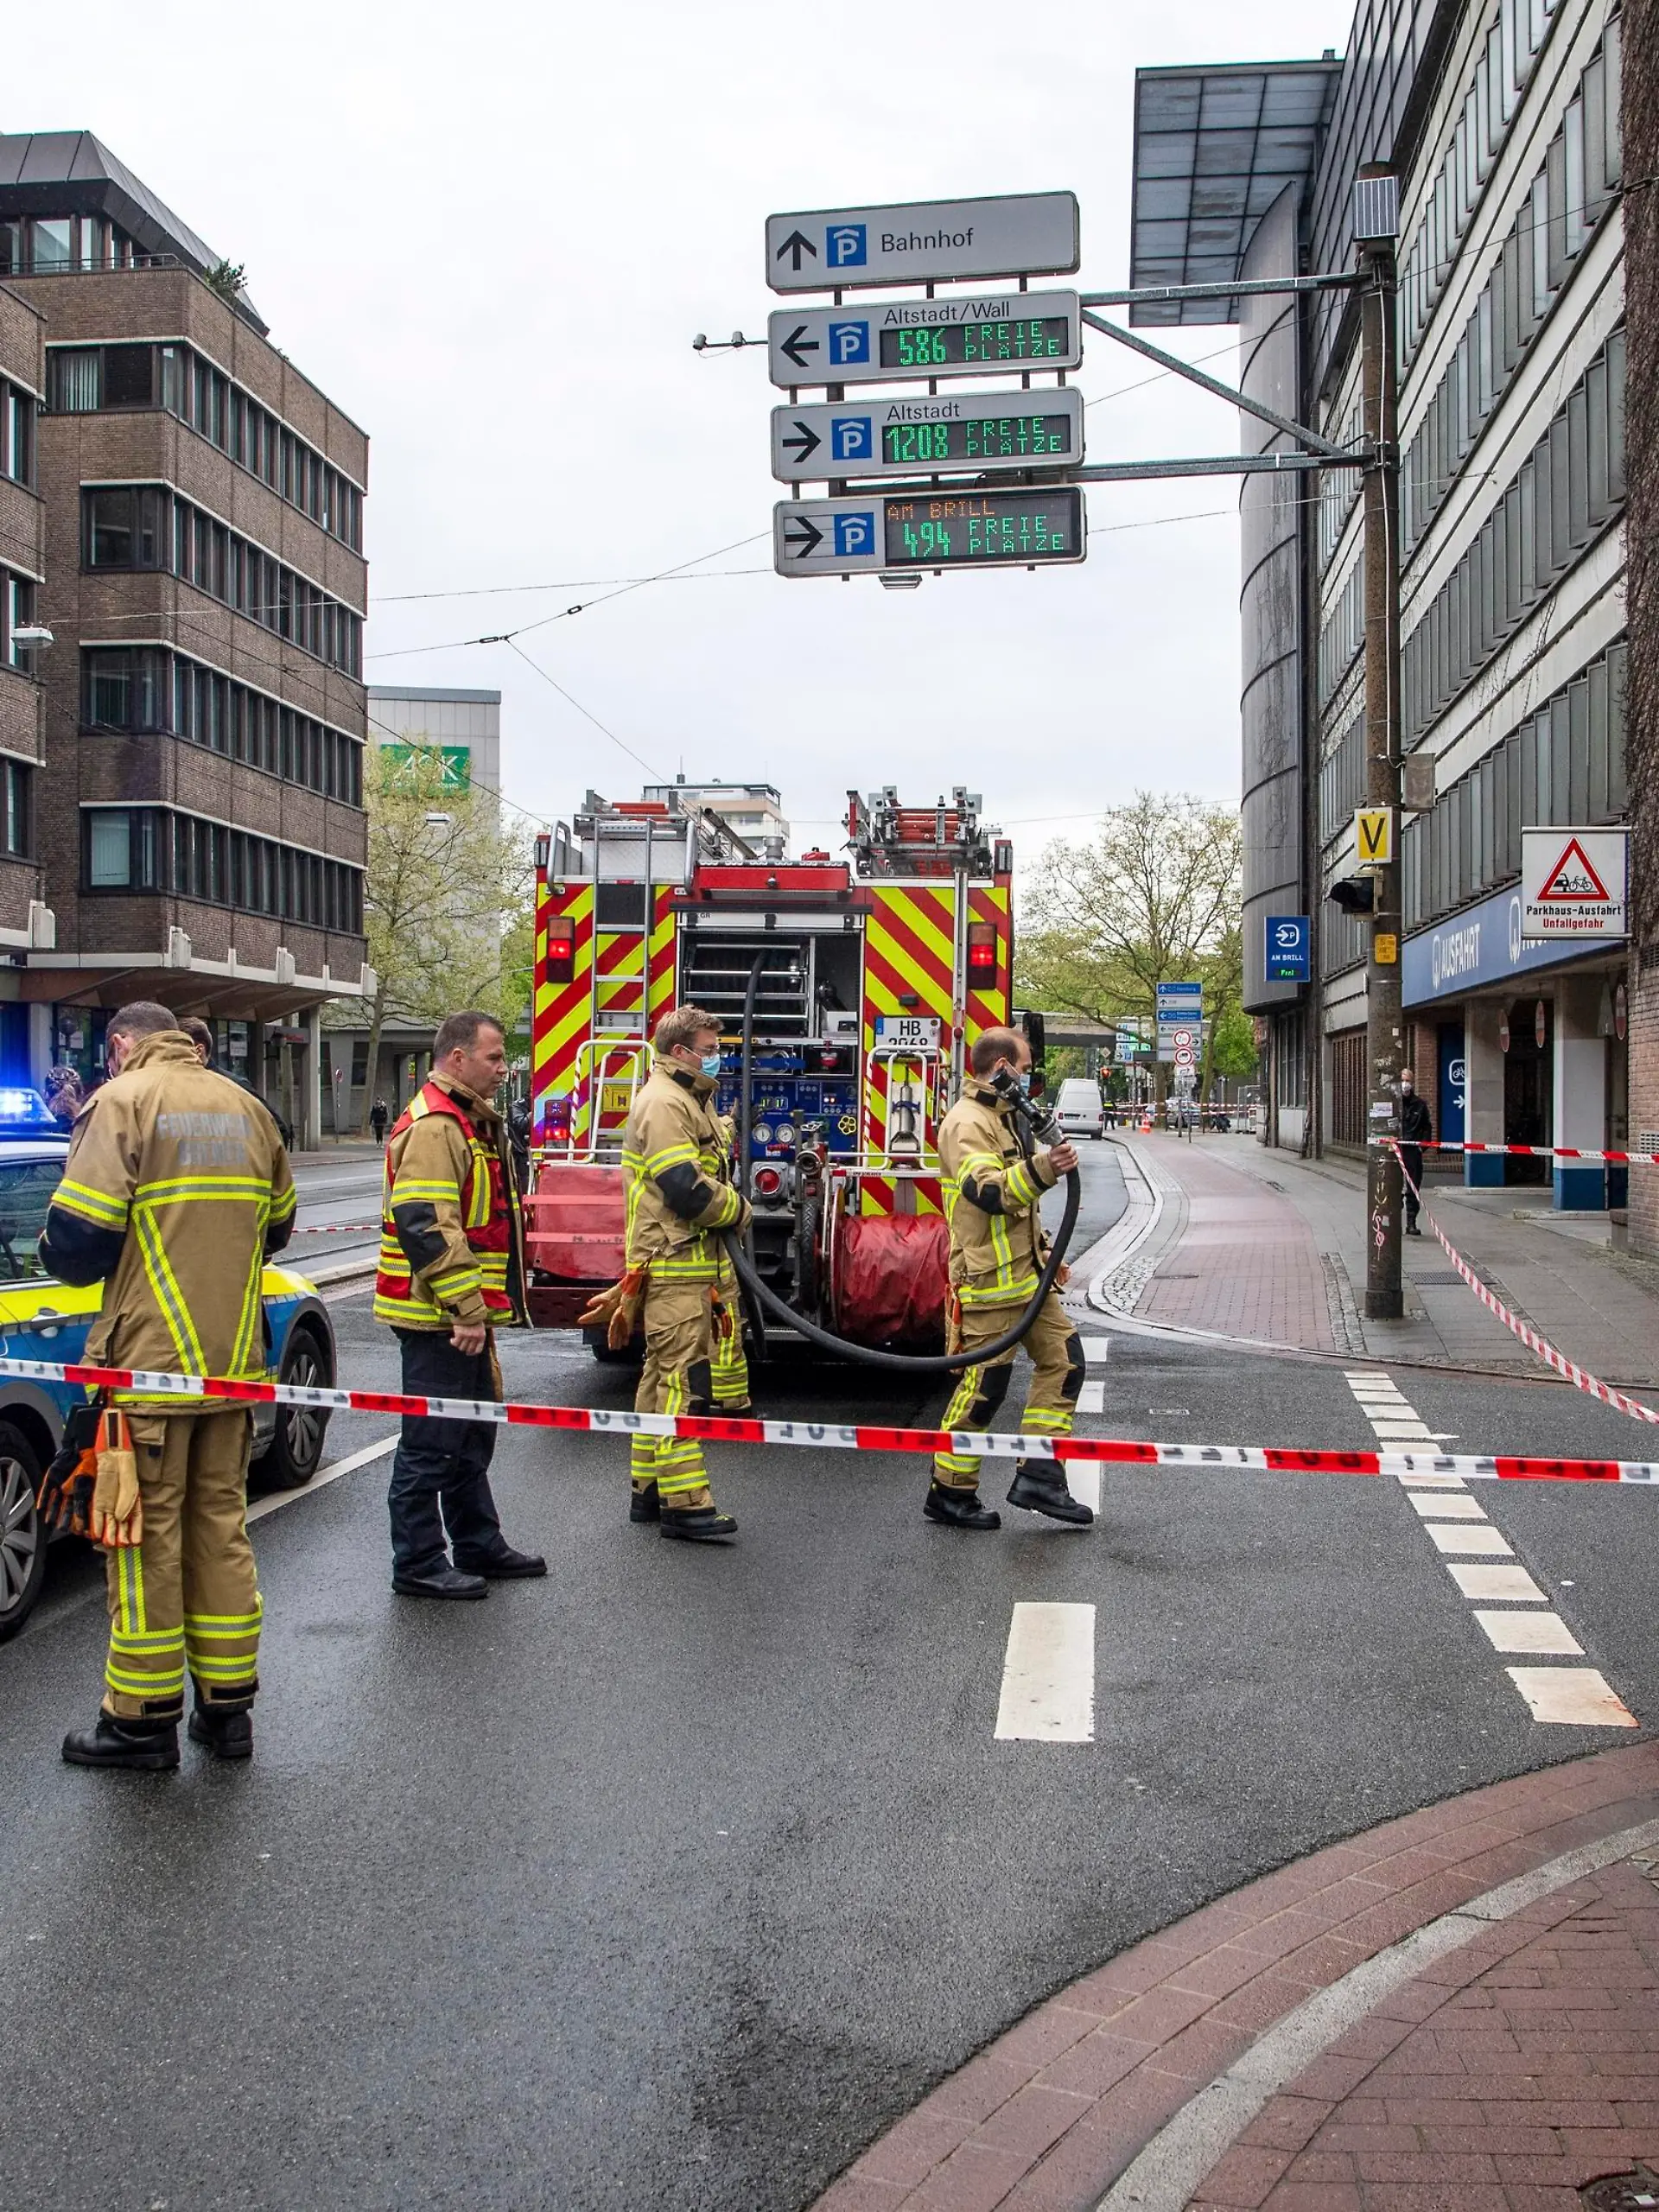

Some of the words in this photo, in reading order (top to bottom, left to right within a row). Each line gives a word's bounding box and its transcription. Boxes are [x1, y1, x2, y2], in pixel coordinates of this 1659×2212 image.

[837, 238, 857, 264] P
[881, 227, 974, 252] Bahnhof
[884, 302, 1009, 325] Altstadt/Wall
[964, 321, 1042, 342] FREIE
[840, 335, 861, 361] P
[899, 328, 946, 365] 586
[965, 339, 1059, 361] PLÄTZE
[887, 402, 960, 421] Altstadt
[967, 417, 1044, 437] FREIE
[842, 431, 863, 457] P
[886, 424, 949, 461] 1208
[967, 435, 1061, 456] PLÄTZE
[887, 504, 913, 520] AM
[930, 499, 995, 518] BRILL
[969, 515, 1047, 536] FREIE
[845, 528, 865, 553] P
[904, 521, 950, 557] 494
[969, 533, 1064, 554] PLÄTZE
[1360, 817, 1386, 854] V
[1526, 905, 1621, 915] Parkhaus-Ausfahrt
[1543, 918, 1605, 930] Unfallgefahr
[1440, 922, 1480, 979] AUSFAHRT
[899, 1020, 921, 1036] HB
